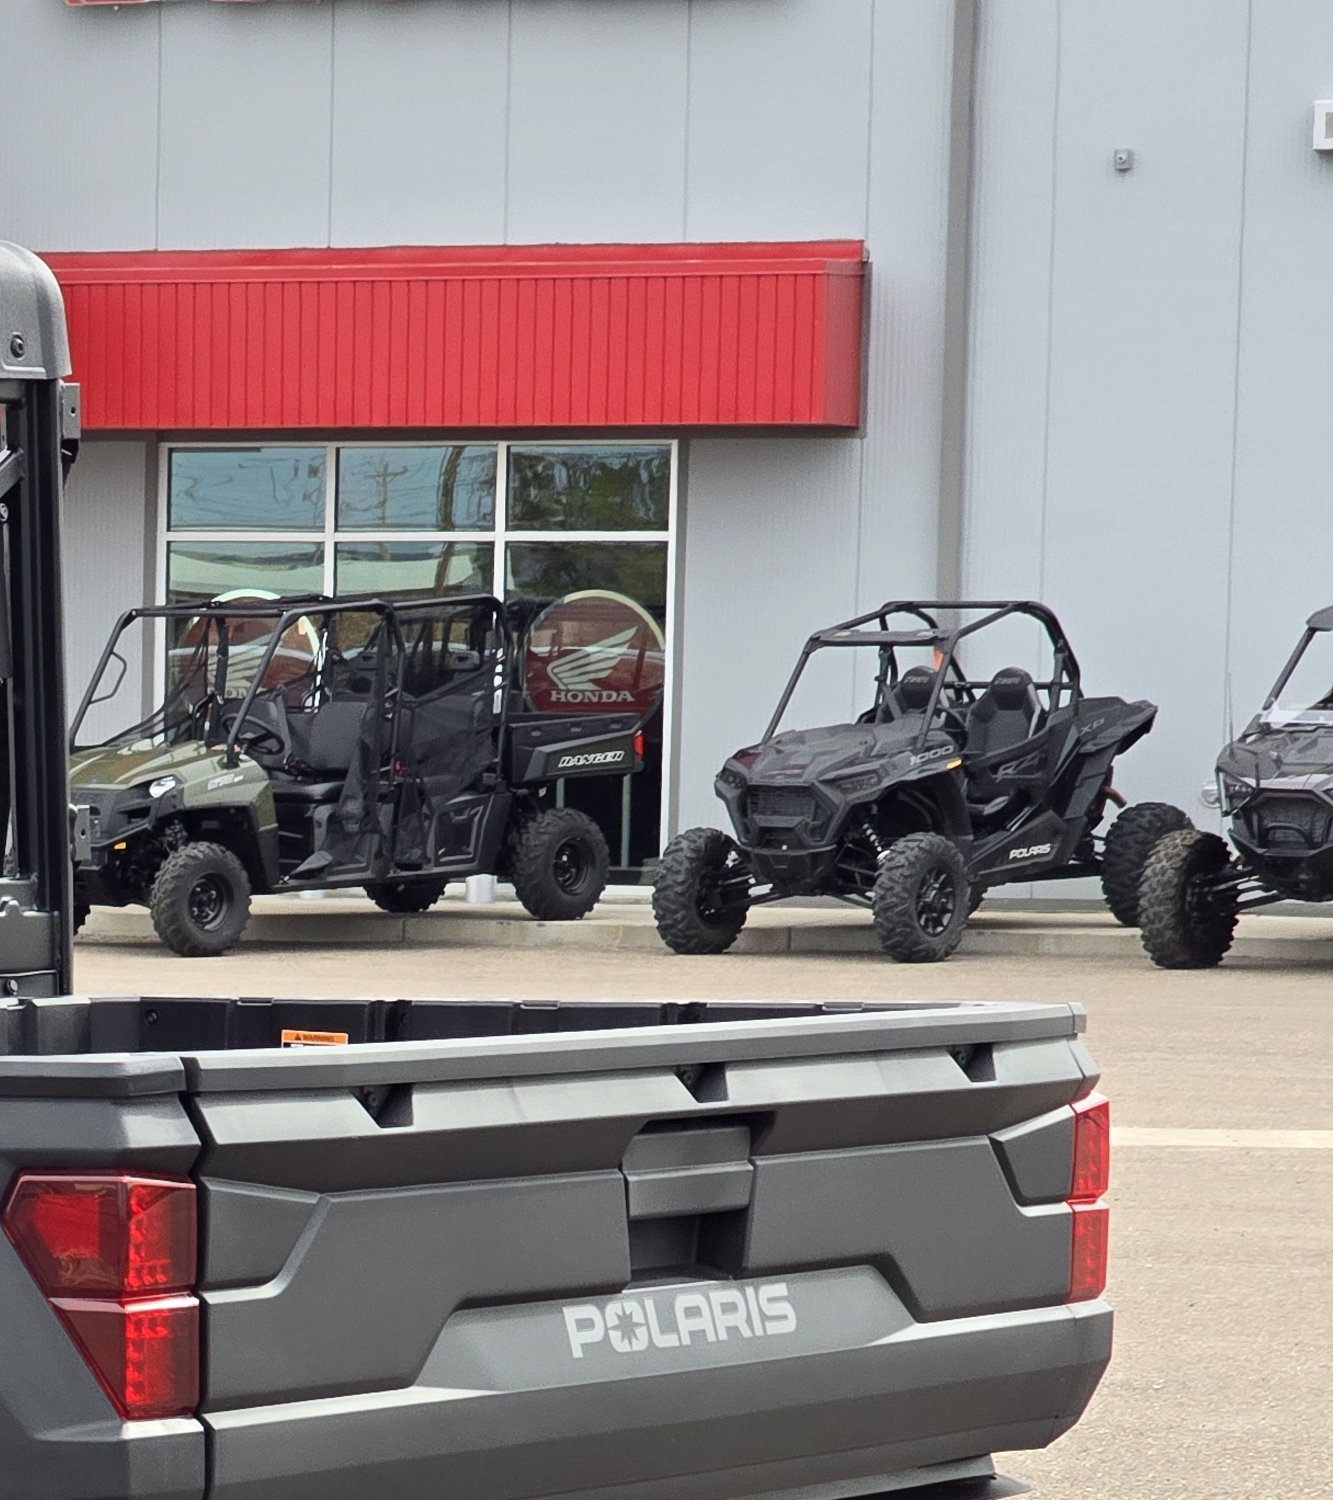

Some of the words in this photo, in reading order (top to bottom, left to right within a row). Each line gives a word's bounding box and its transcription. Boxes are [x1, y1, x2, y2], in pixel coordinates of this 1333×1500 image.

[550, 690, 635, 702] HONDA
[1080, 718, 1105, 735] XP
[910, 745, 954, 766] 1000
[1009, 843, 1051, 860] POLARIS
[562, 1282, 797, 1358] POLARIS
